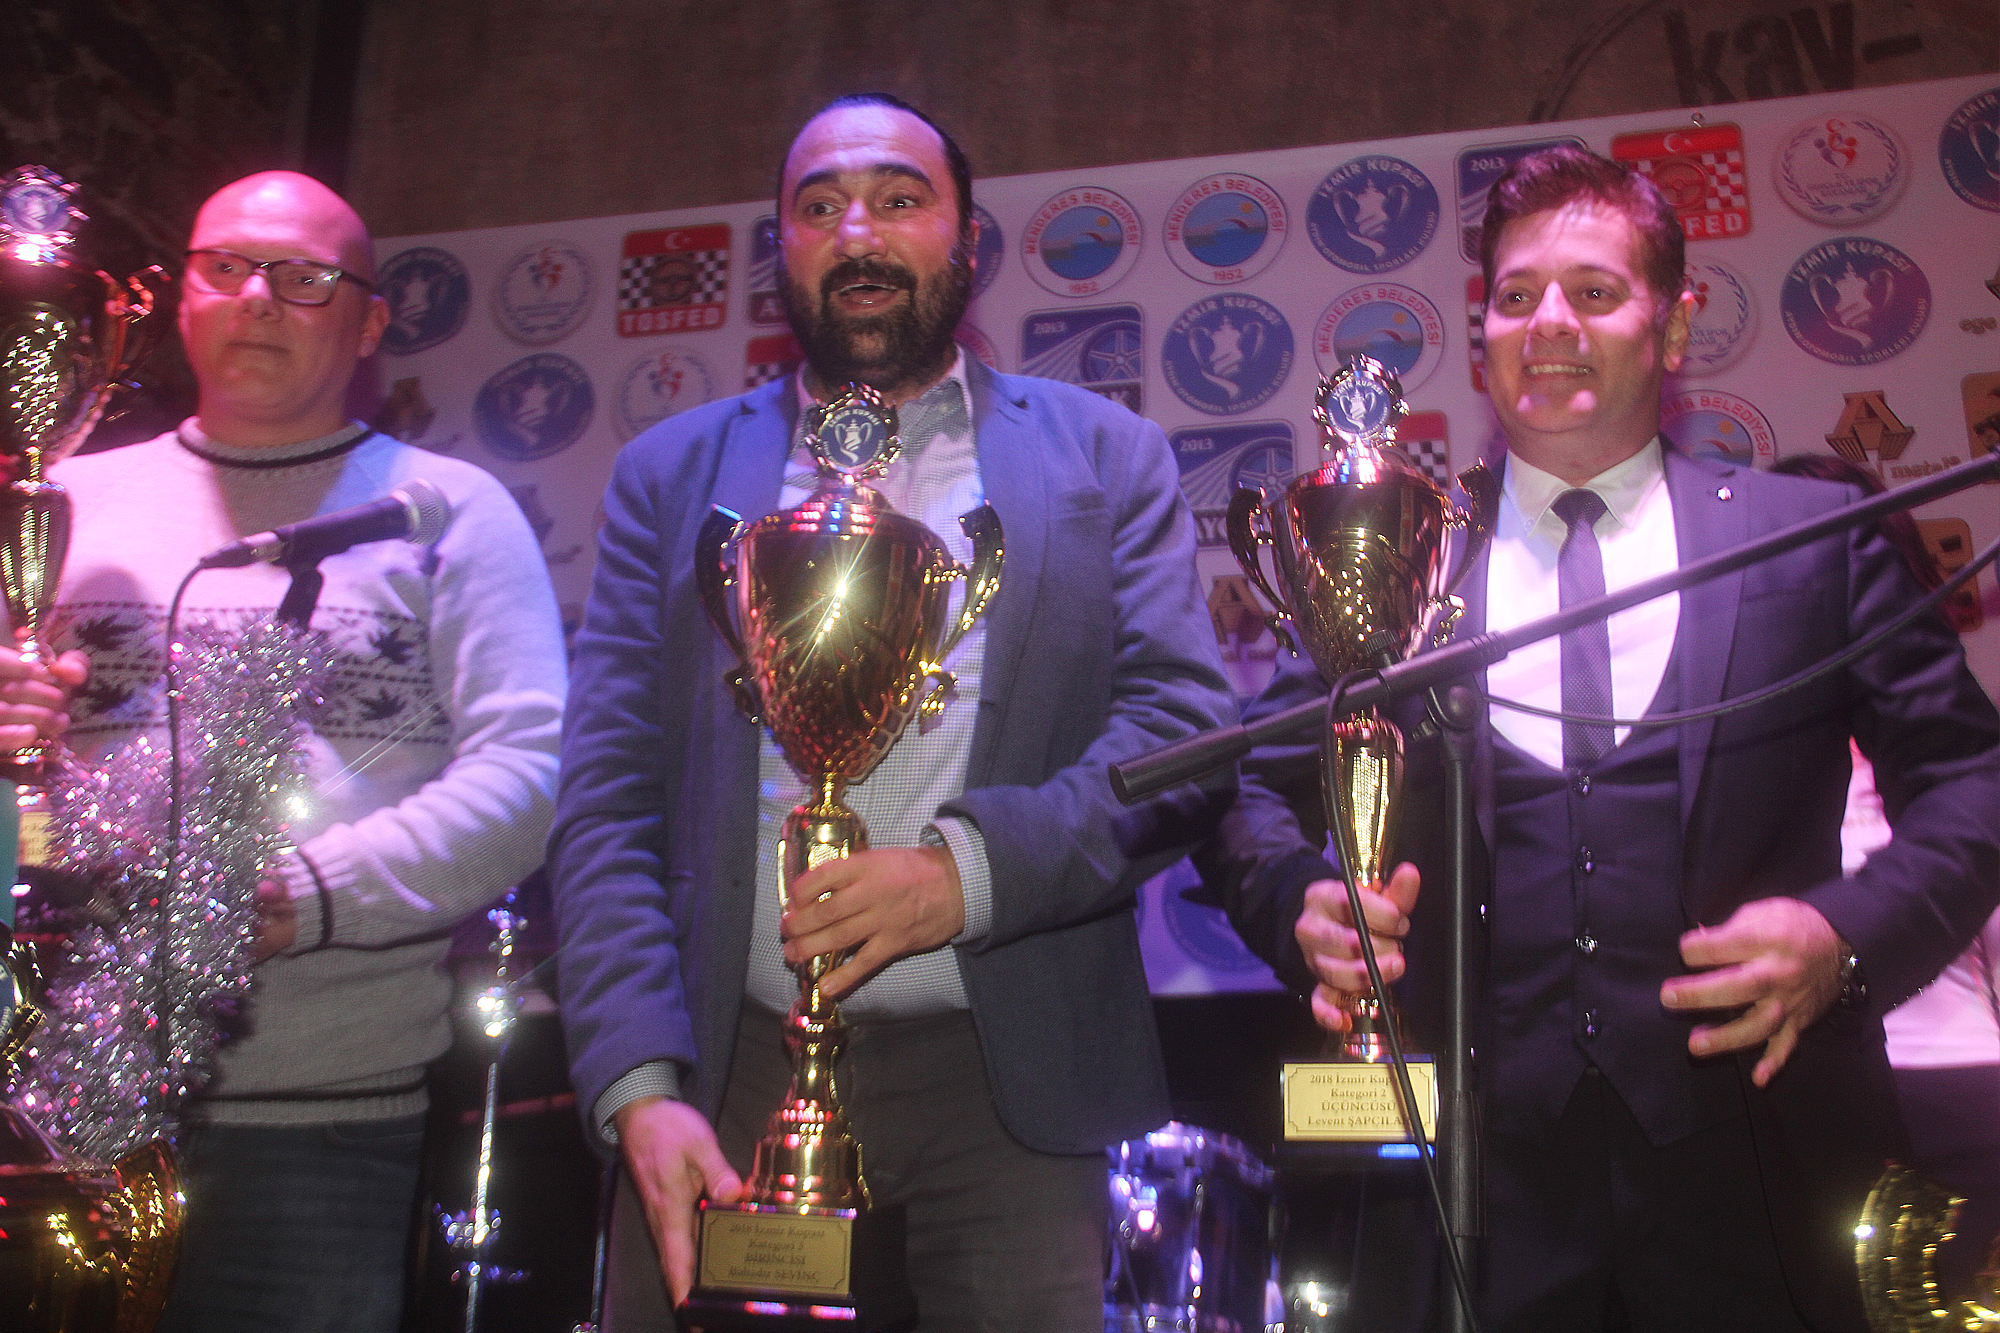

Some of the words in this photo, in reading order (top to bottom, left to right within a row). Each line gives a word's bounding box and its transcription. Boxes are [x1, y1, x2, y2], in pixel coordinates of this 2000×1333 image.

[1367, 160, 1427, 188] KUPASI
[1470, 157, 1505, 172] 2013
[1168, 181, 1222, 241] MENDERES
[1025, 194, 1079, 254] MENDERES
[1685, 213, 1743, 236] FED
[1845, 241, 1912, 273] KUPASI
[1213, 268, 1244, 281] 1952
[1069, 282, 1099, 294] 1952
[622, 307, 720, 333] TOSFED
[1223, 297, 1282, 326] KUPASI
[1319, 290, 1372, 354] MENDERES
[1179, 437, 1214, 451] 2013
[1310, 1074, 1333, 1084] 2018
[1336, 1072, 1367, 1084] İzmir
[1331, 1088, 1377, 1099] Kategori
[1381, 1088, 1387, 1097] 2
[1321, 1100, 1396, 1113] ÜÇÜNCÜSÜ
[1308, 1116, 1344, 1125] Levent
[1347, 1116, 1403, 1127] ŞAPÇILA
